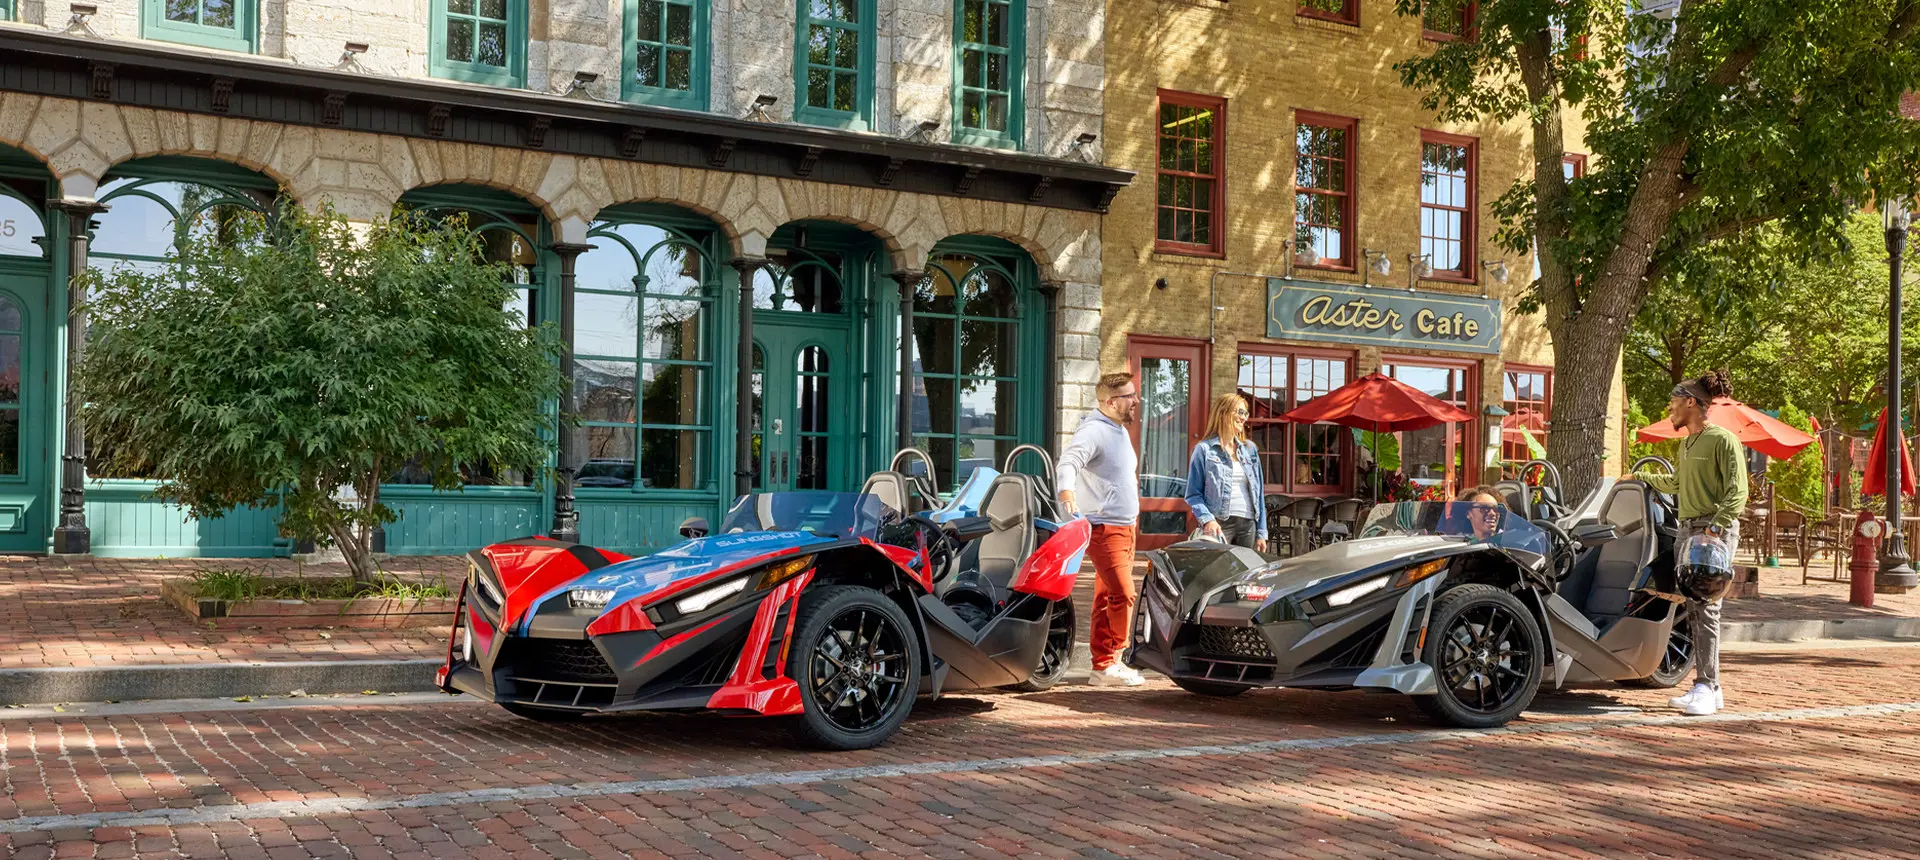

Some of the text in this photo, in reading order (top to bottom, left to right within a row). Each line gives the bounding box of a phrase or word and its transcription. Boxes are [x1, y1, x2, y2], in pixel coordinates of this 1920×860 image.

[0, 219, 16, 237] 5
[1302, 295, 1479, 338] Aster Cafe
[716, 531, 801, 547] SLINGSHOT
